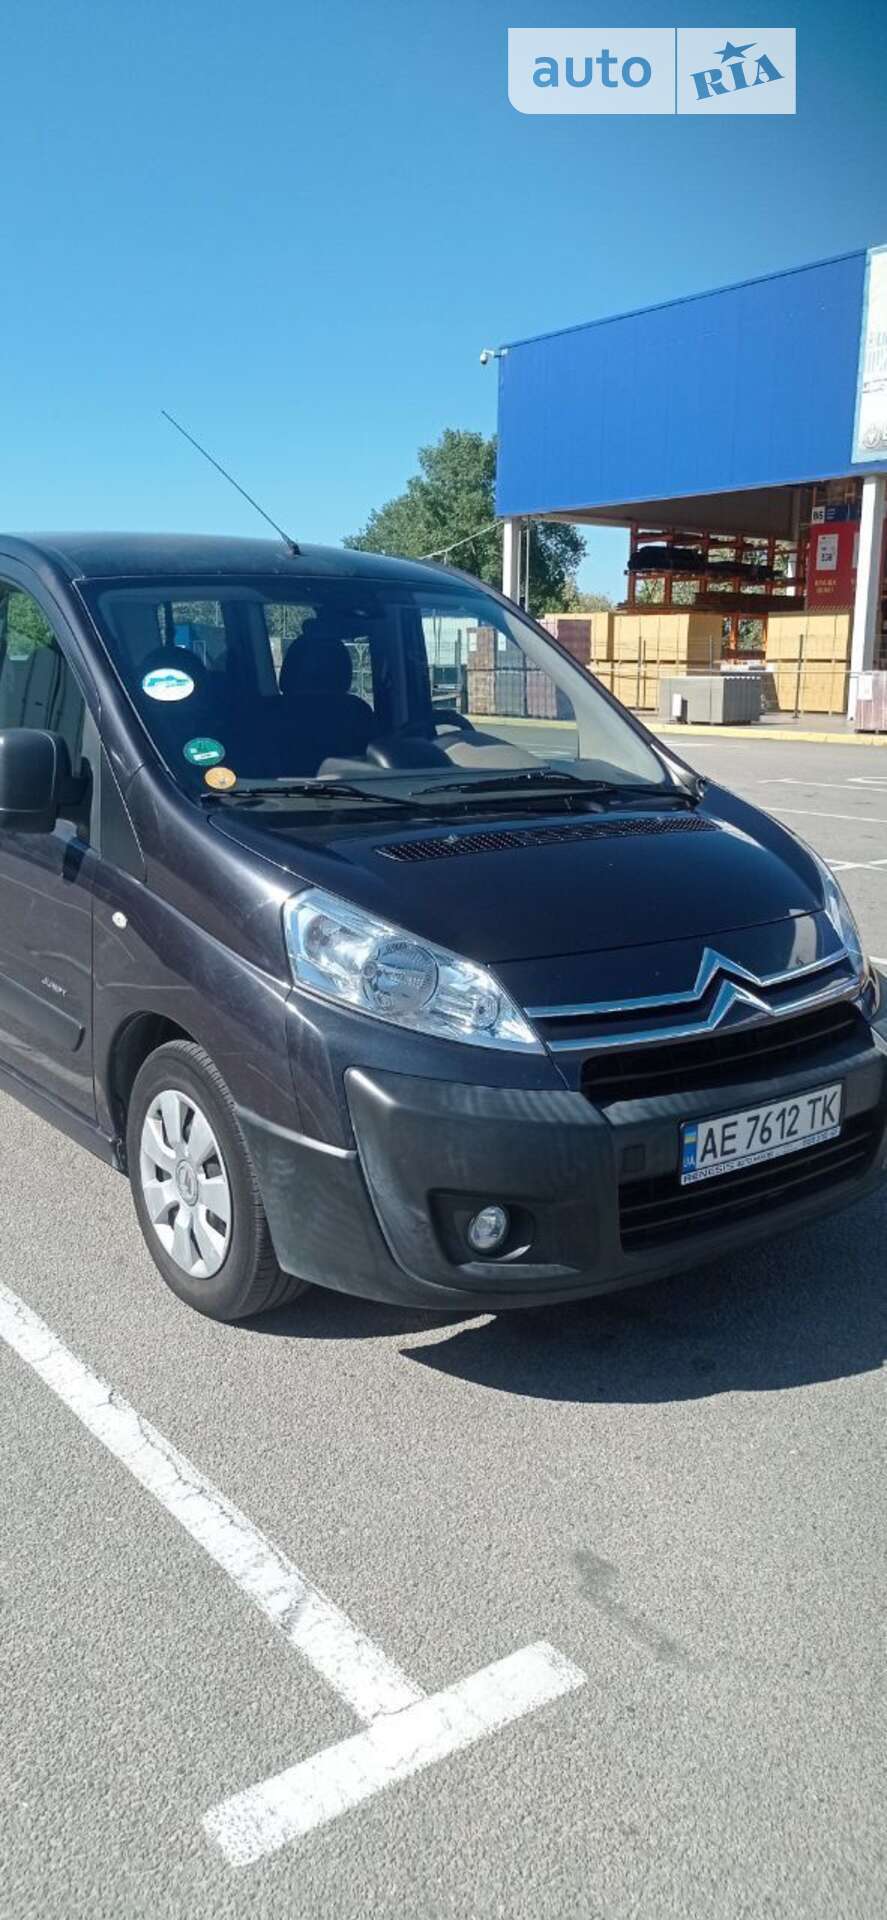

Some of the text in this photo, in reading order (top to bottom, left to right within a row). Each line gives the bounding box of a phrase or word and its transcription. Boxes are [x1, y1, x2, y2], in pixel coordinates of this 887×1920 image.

[700, 1120, 738, 1163] AE
[746, 1104, 800, 1150] 7612
[807, 1091, 838, 1130] TK
